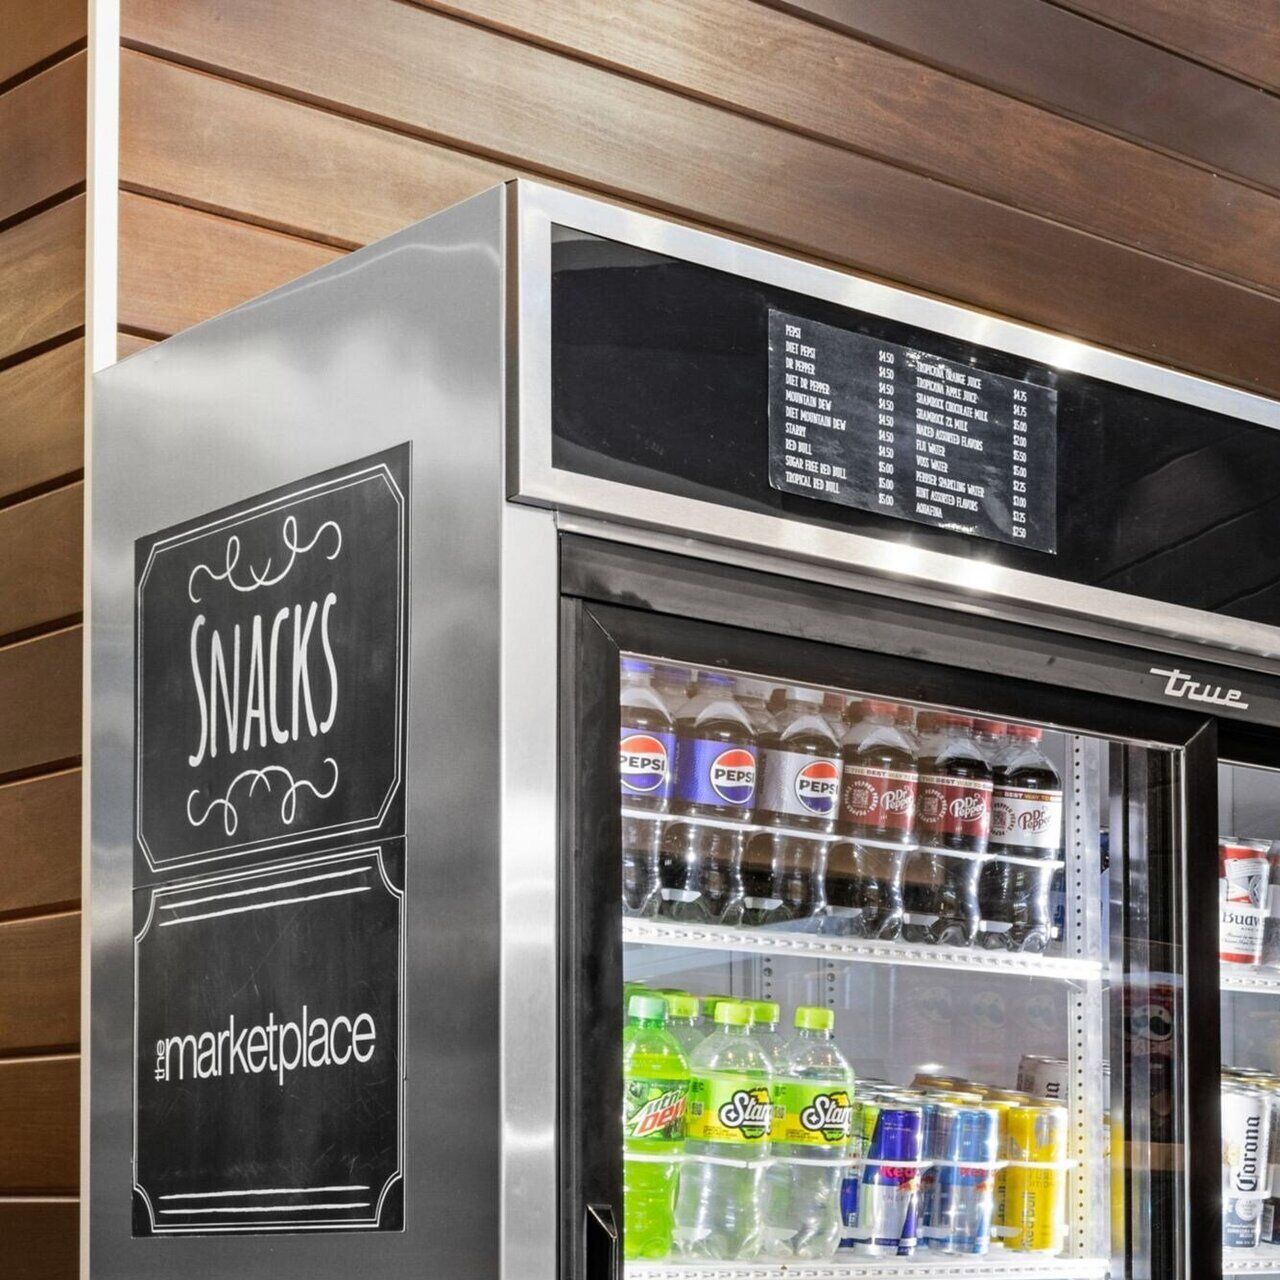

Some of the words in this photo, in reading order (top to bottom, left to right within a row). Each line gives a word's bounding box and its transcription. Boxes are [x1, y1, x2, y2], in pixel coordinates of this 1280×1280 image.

[188, 592, 338, 768] SNACKS
[154, 1038, 166, 1082] the
[165, 1008, 376, 1085] marketplace
[1237, 1116, 1261, 1192] Corona
